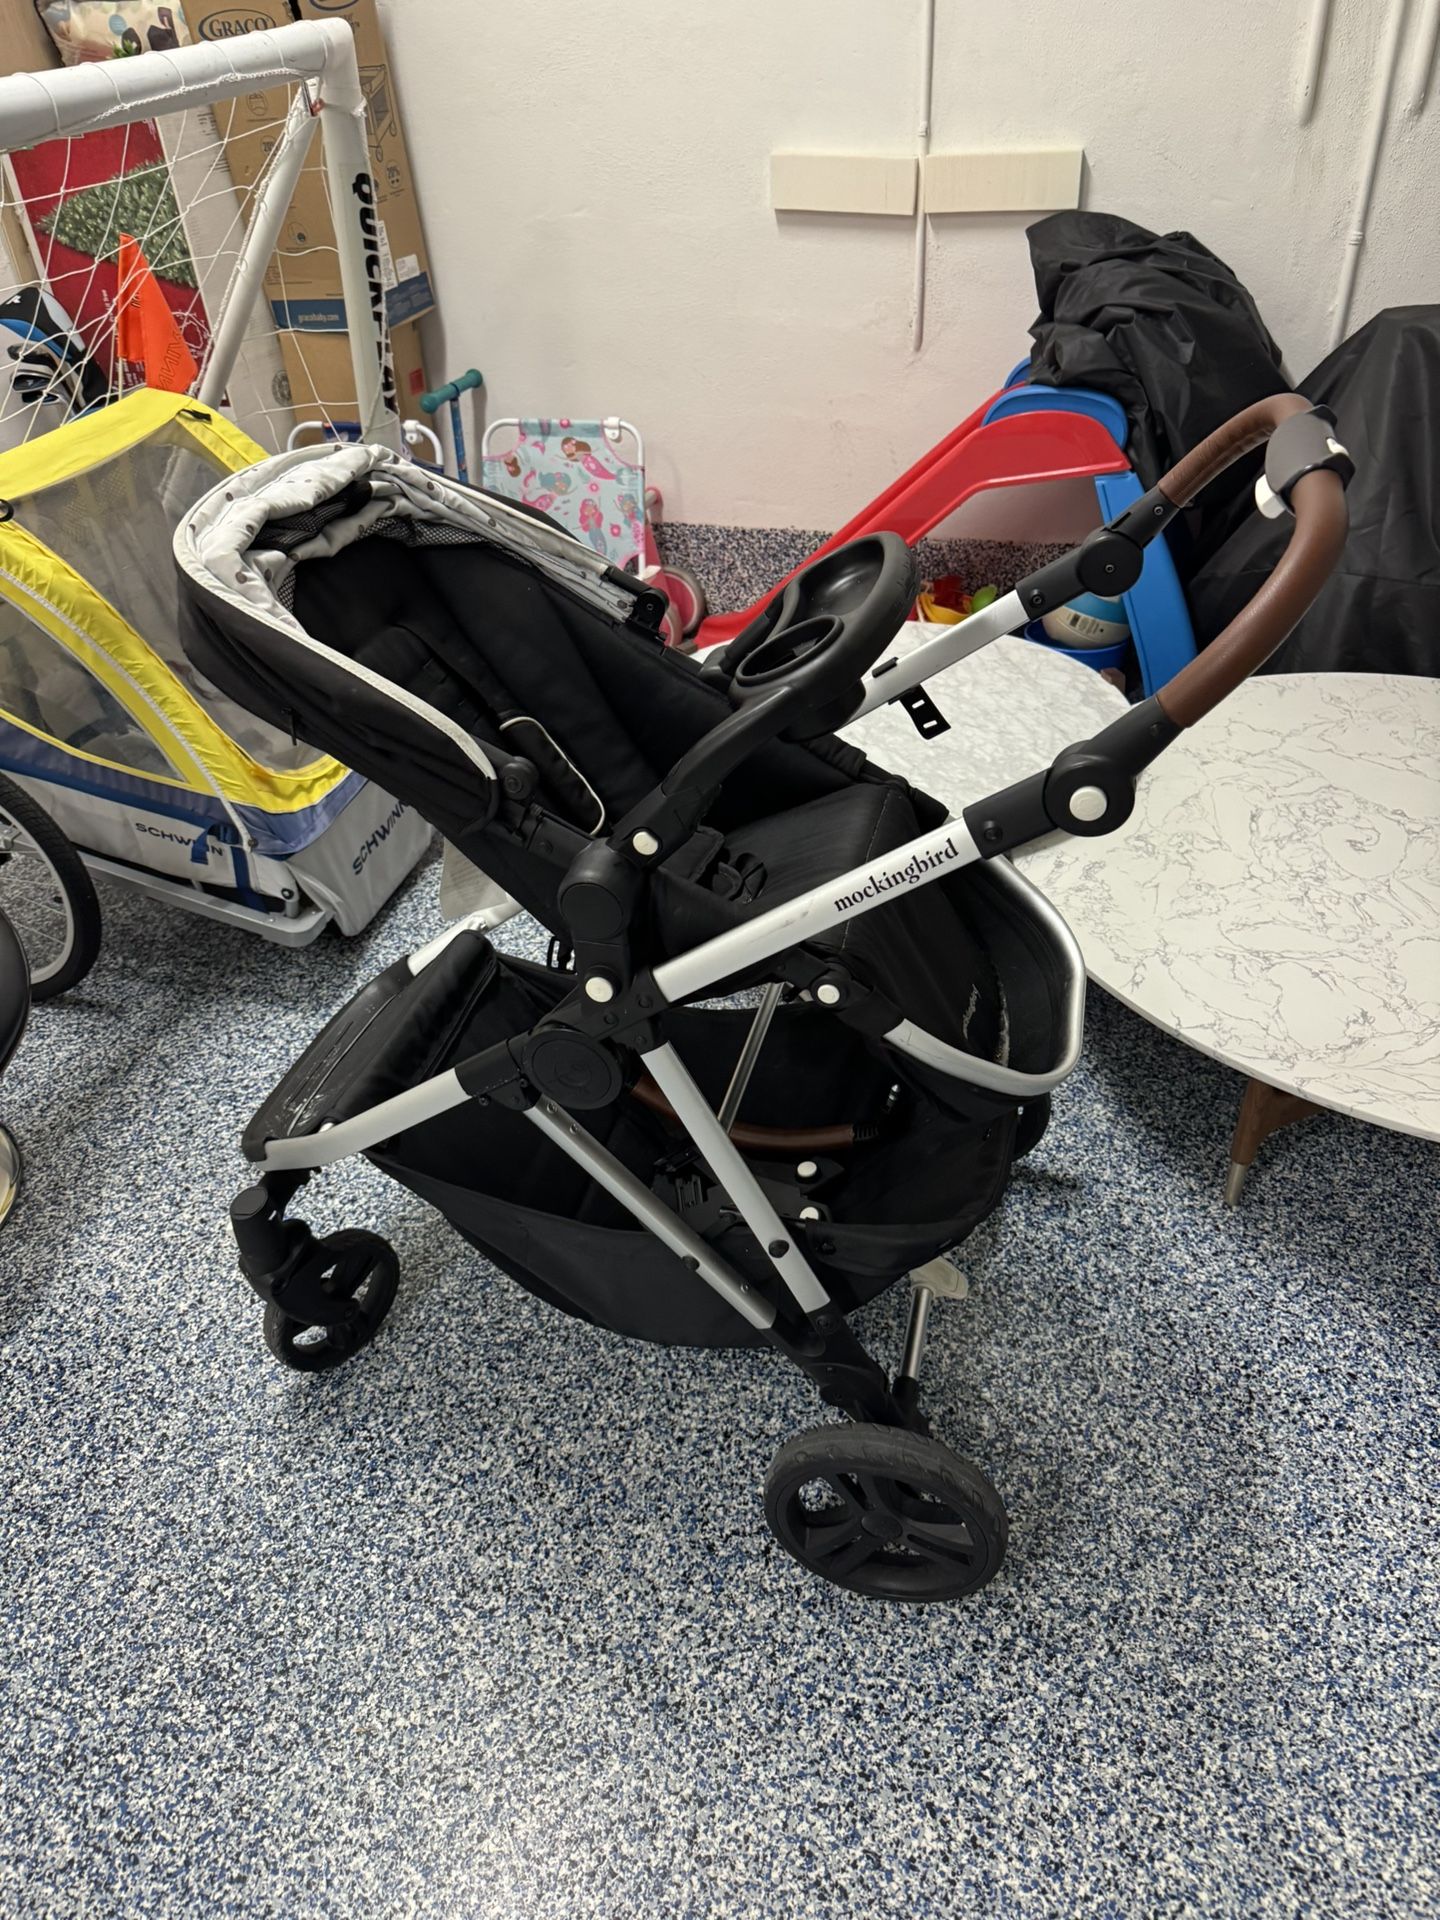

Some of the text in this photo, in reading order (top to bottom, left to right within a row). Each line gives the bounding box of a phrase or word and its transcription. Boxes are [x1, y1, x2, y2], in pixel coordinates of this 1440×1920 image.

[209, 17, 267, 38] GRACO
[135, 822, 224, 857] SCHWN
[834, 838, 959, 912] mockingbird
